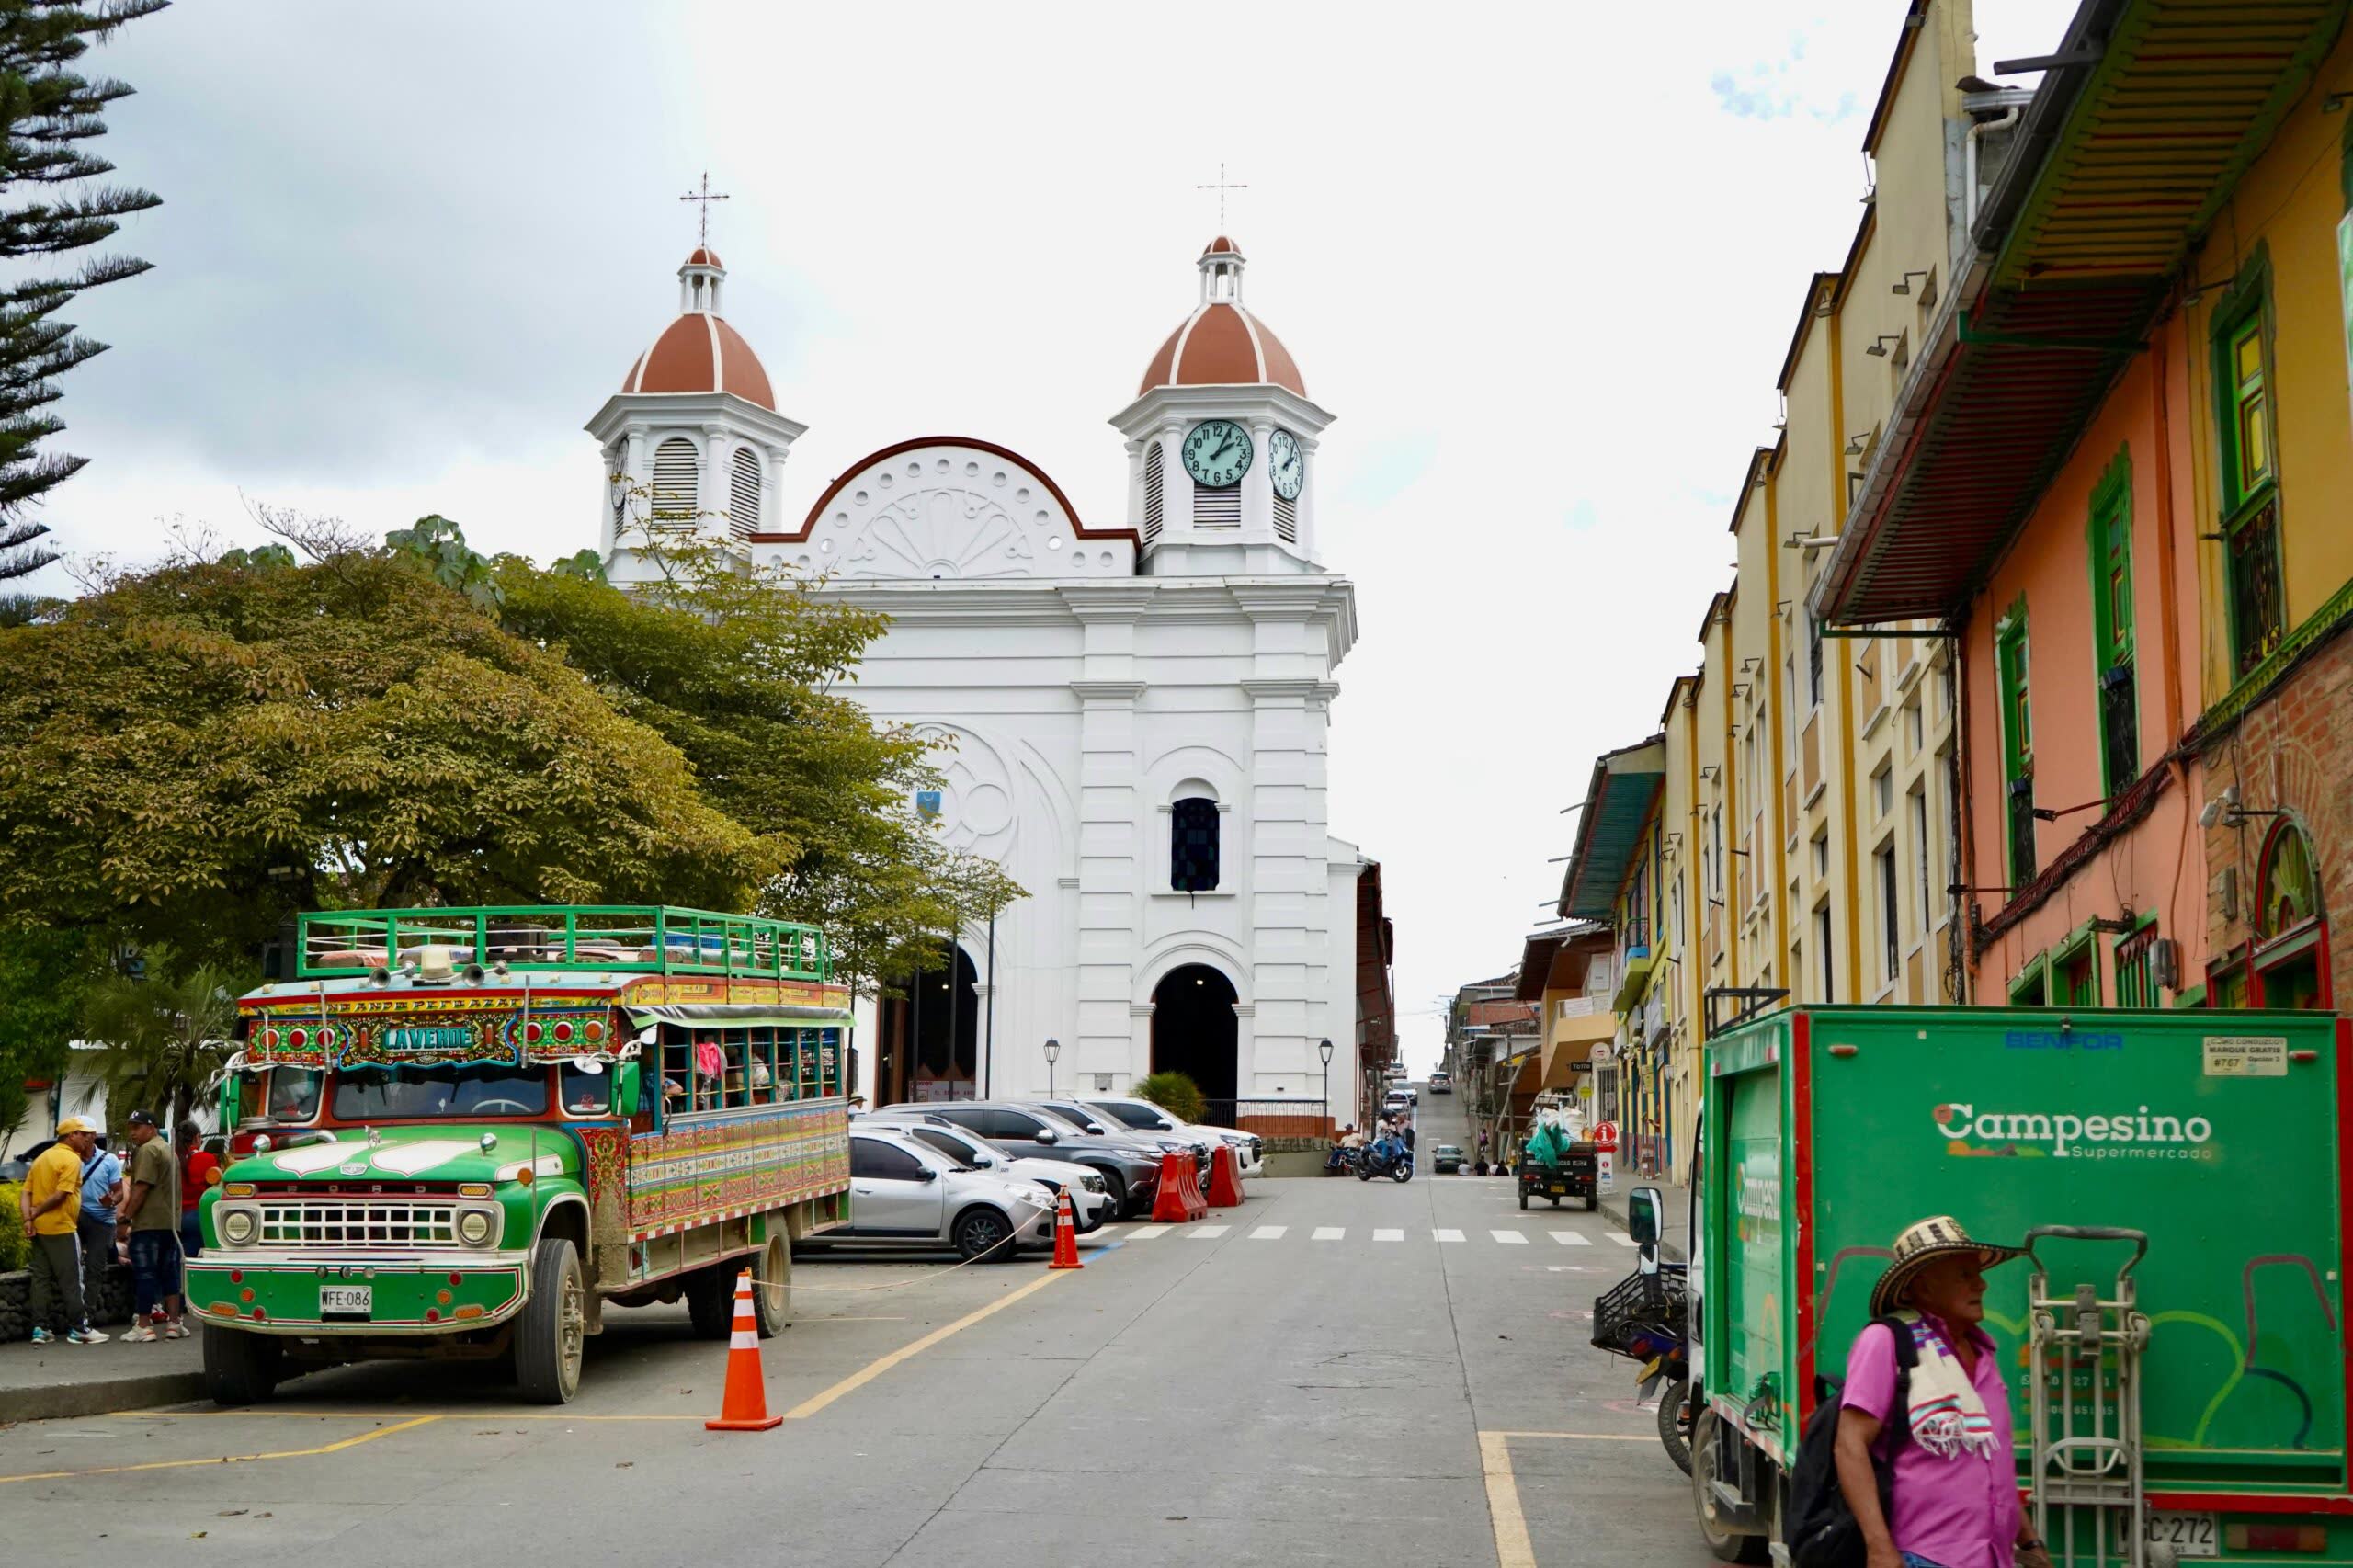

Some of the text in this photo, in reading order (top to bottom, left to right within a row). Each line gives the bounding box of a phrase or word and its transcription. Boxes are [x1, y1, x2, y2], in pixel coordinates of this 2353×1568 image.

[1202, 429, 1210, 440] 11
[1213, 425, 1222, 437] 12
[1193, 437, 1202, 449] 10
[1235, 436, 1243, 447] 2
[1188, 449, 1195, 460] 9
[1240, 449, 1246, 460] 3
[1192, 461, 1199, 472] 8
[1235, 460, 1243, 471] 4
[1202, 469, 1210, 480] 7
[1213, 472, 1221, 483] 6
[1226, 469, 1232, 480] 5
[2006, 1032, 2123, 1050] BENFOR
[2213, 1058, 2241, 1067] #767
[1935, 1103, 2211, 1157] Campesino
[2072, 1145, 2212, 1161] Supermercado
